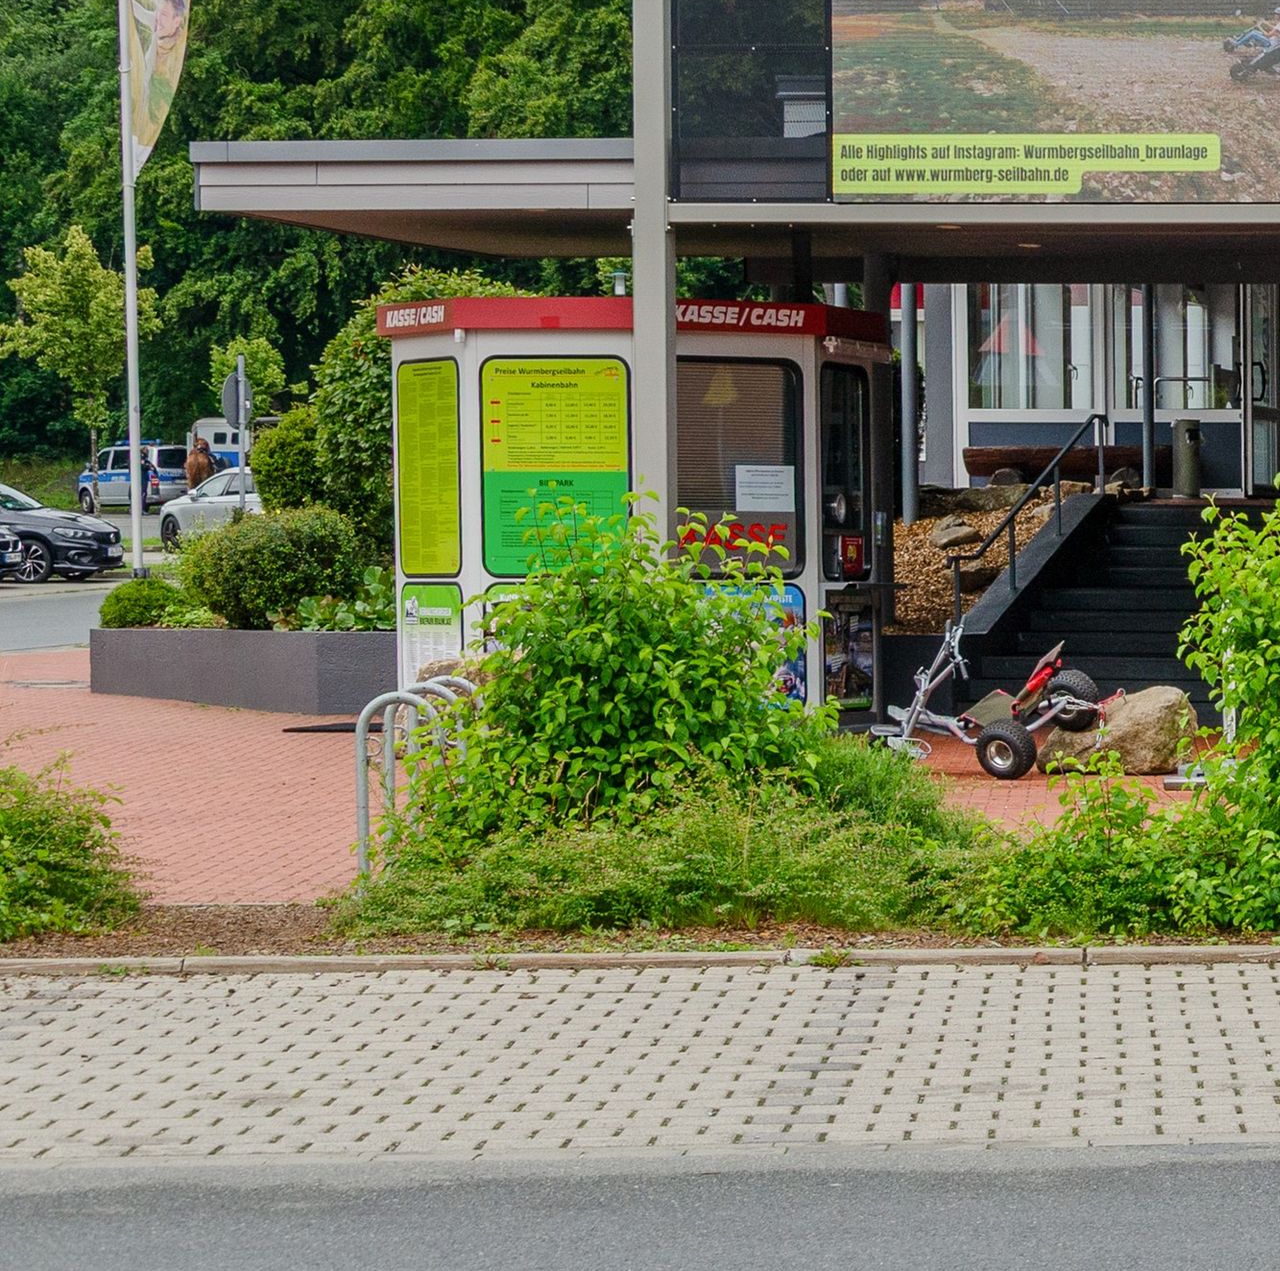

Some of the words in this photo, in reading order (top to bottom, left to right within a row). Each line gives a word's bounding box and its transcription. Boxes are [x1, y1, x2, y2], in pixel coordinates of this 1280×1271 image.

[840, 144, 863, 160] Alle
[866, 144, 928, 162] Highlights
[931, 144, 952, 160] auf
[954, 144, 1020, 162] Instagram:
[1023, 144, 1208, 162] Wurmbergseilbahn_braunlage
[840, 167, 868, 182] oder
[872, 167, 891, 182] auf
[894, 167, 1069, 184] www.wurmberg-seilbahn.de
[386, 305, 445, 328] KASSE/CASH
[494, 367, 516, 375] Preise
[518, 367, 586, 377] Wurmbergseilbahn
[531, 381, 578, 389] Kabinenbahn
